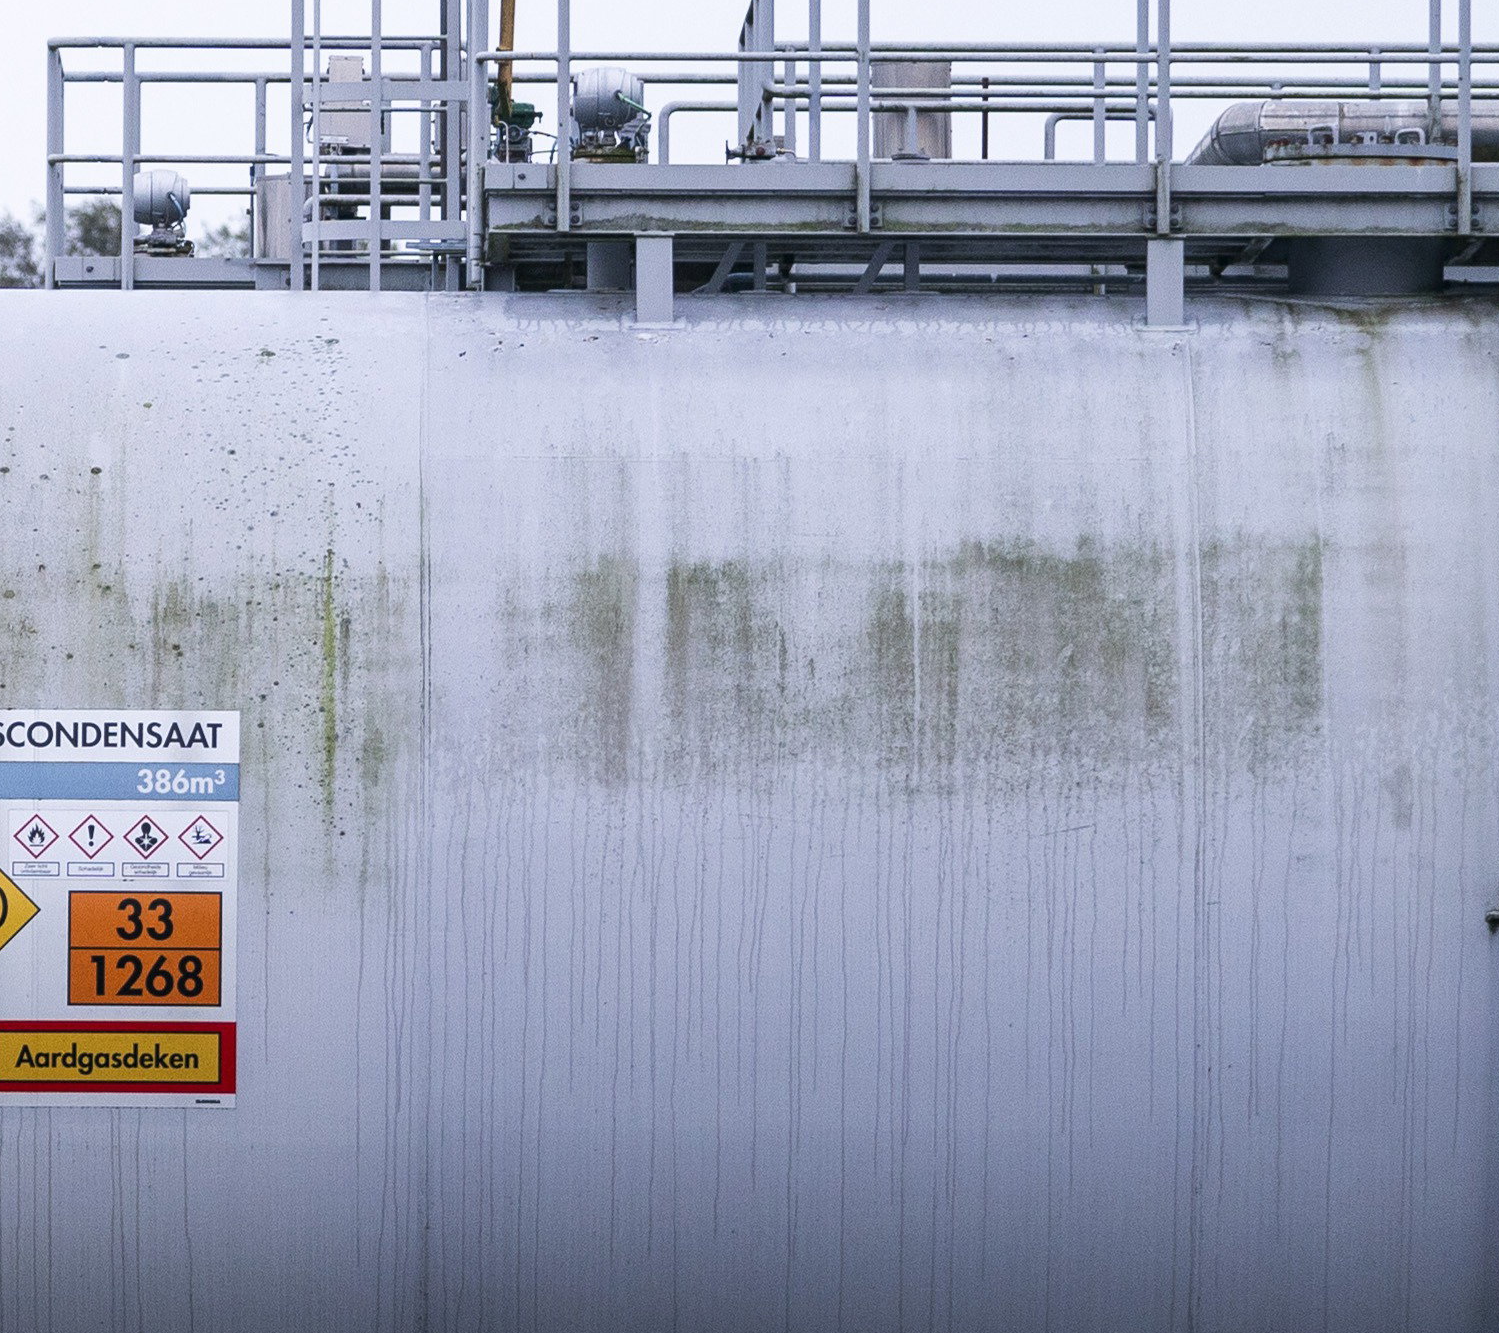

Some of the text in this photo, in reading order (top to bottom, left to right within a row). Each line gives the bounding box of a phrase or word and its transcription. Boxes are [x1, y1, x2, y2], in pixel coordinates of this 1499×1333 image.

[115, 898, 174, 941] 33
[90, 954, 204, 998] 1268
[15, 1042, 200, 1075] Aardgasdeken
